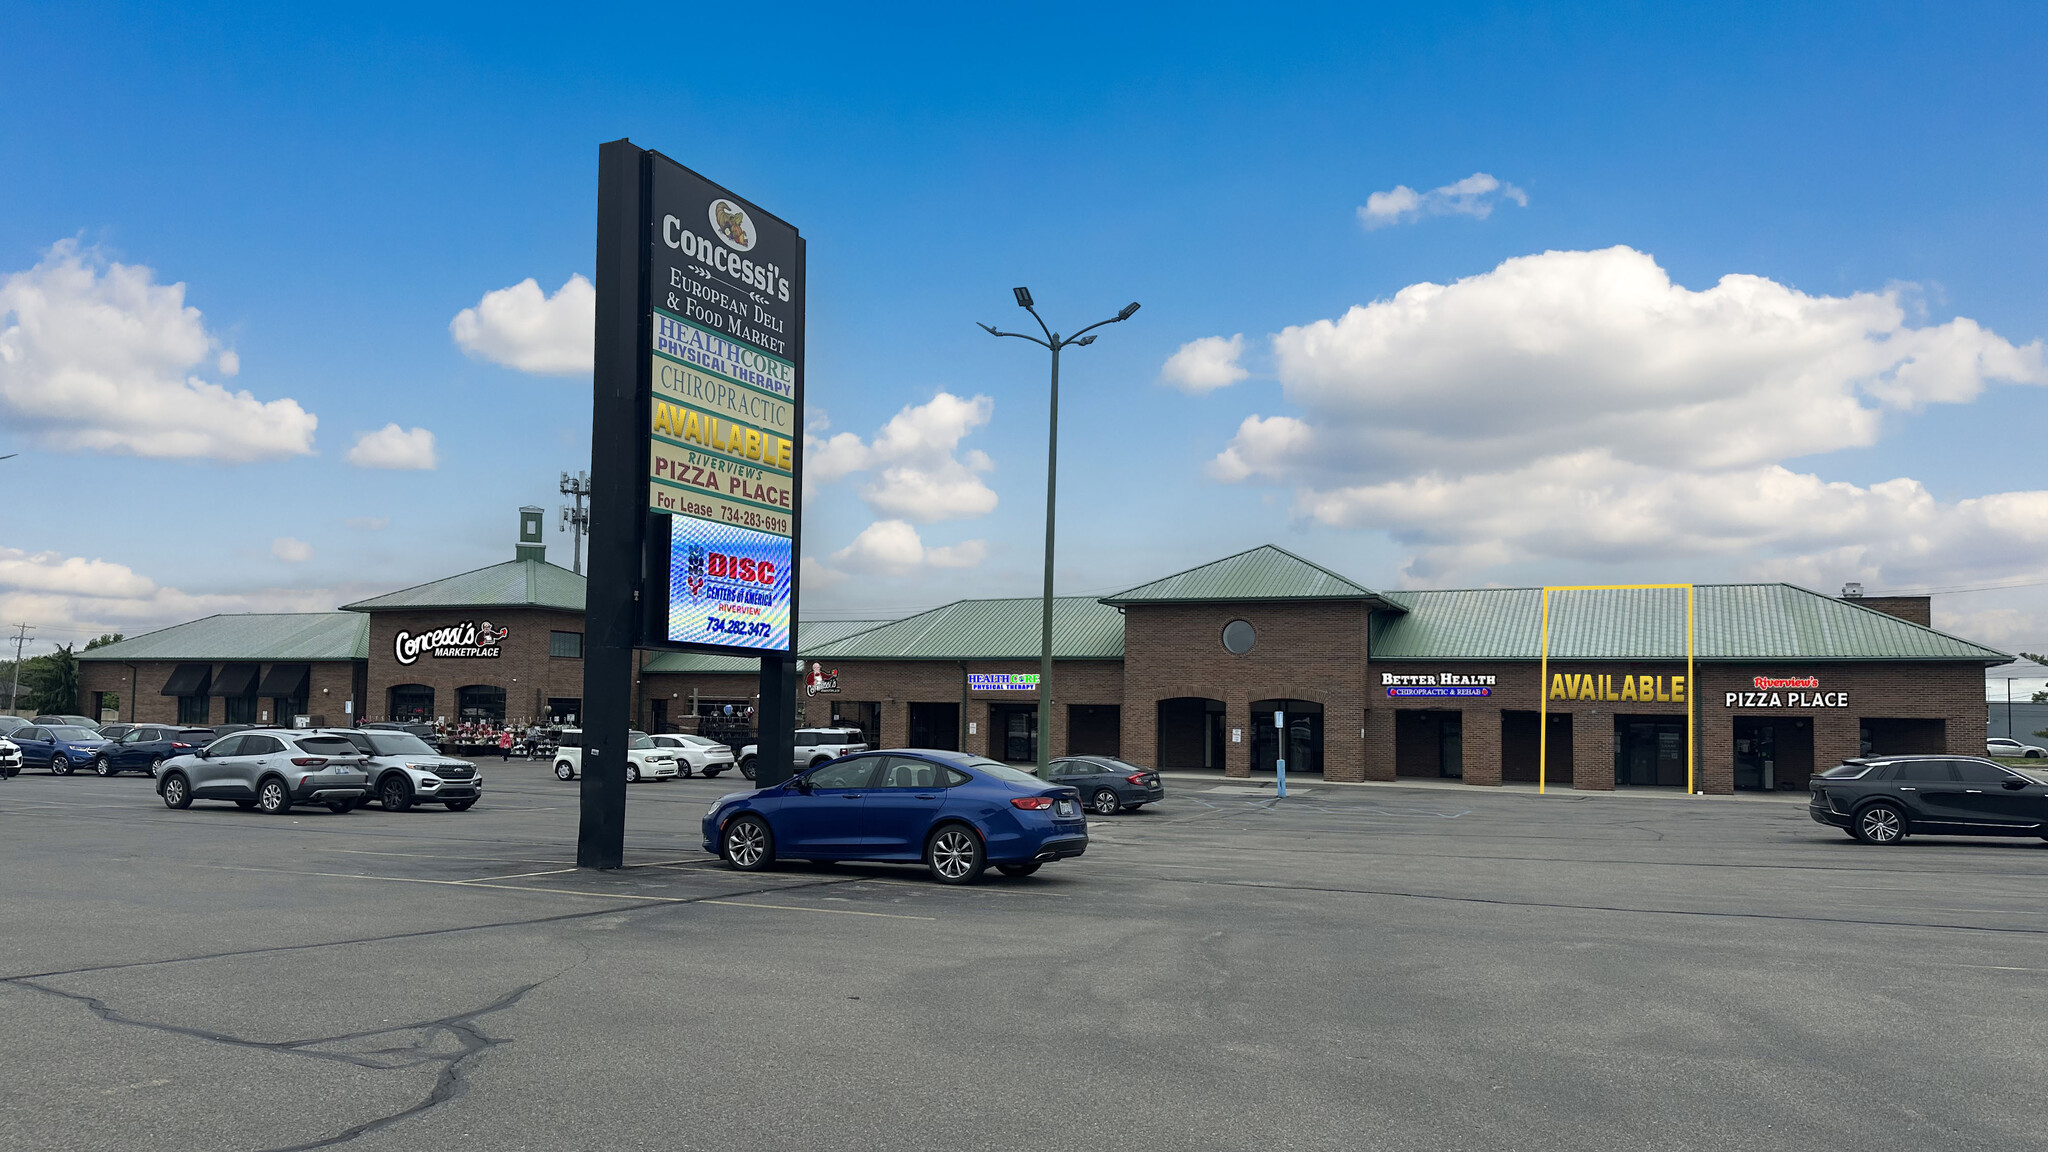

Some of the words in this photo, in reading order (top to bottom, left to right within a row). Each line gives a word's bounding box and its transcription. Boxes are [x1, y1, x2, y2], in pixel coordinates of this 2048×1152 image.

[662, 214, 790, 302] Concessi's
[670, 267, 748, 318] EUROPEAN
[754, 305, 784, 334] DELI
[666, 291, 680, 311] &
[686, 299, 723, 328] FOOD
[728, 314, 785, 354] MARKET
[658, 337, 728, 374] PHYSICAL
[731, 363, 791, 397] THERAPY
[661, 365, 786, 427] CHIROPRACTIC
[653, 402, 791, 470] AVAILABLE
[655, 456, 720, 491] PIZZA
[729, 476, 790, 508] PLACE
[688, 452, 763, 481] RIVERVIEW'S
[657, 491, 676, 510] For
[680, 497, 713, 517] Lease
[721, 505, 787, 533] 734-283-6919
[708, 552, 775, 585] DISC
[706, 586, 736, 603] CENTERS
[744, 592, 773, 607] AMERICA
[718, 603, 761, 616] RIVERVIEW
[396, 622, 475, 664] Concessi's
[706, 616, 771, 638] 734.282.3472
[434, 647, 500, 657] MARKETPLACE
[1381, 673, 1437, 685] BETTER
[1440, 673, 1496, 685] HEALTH
[1753, 676, 1819, 690] Riverview's
[1725, 692, 1782, 707] PIZZA
[1787, 692, 1848, 707] PLACE
